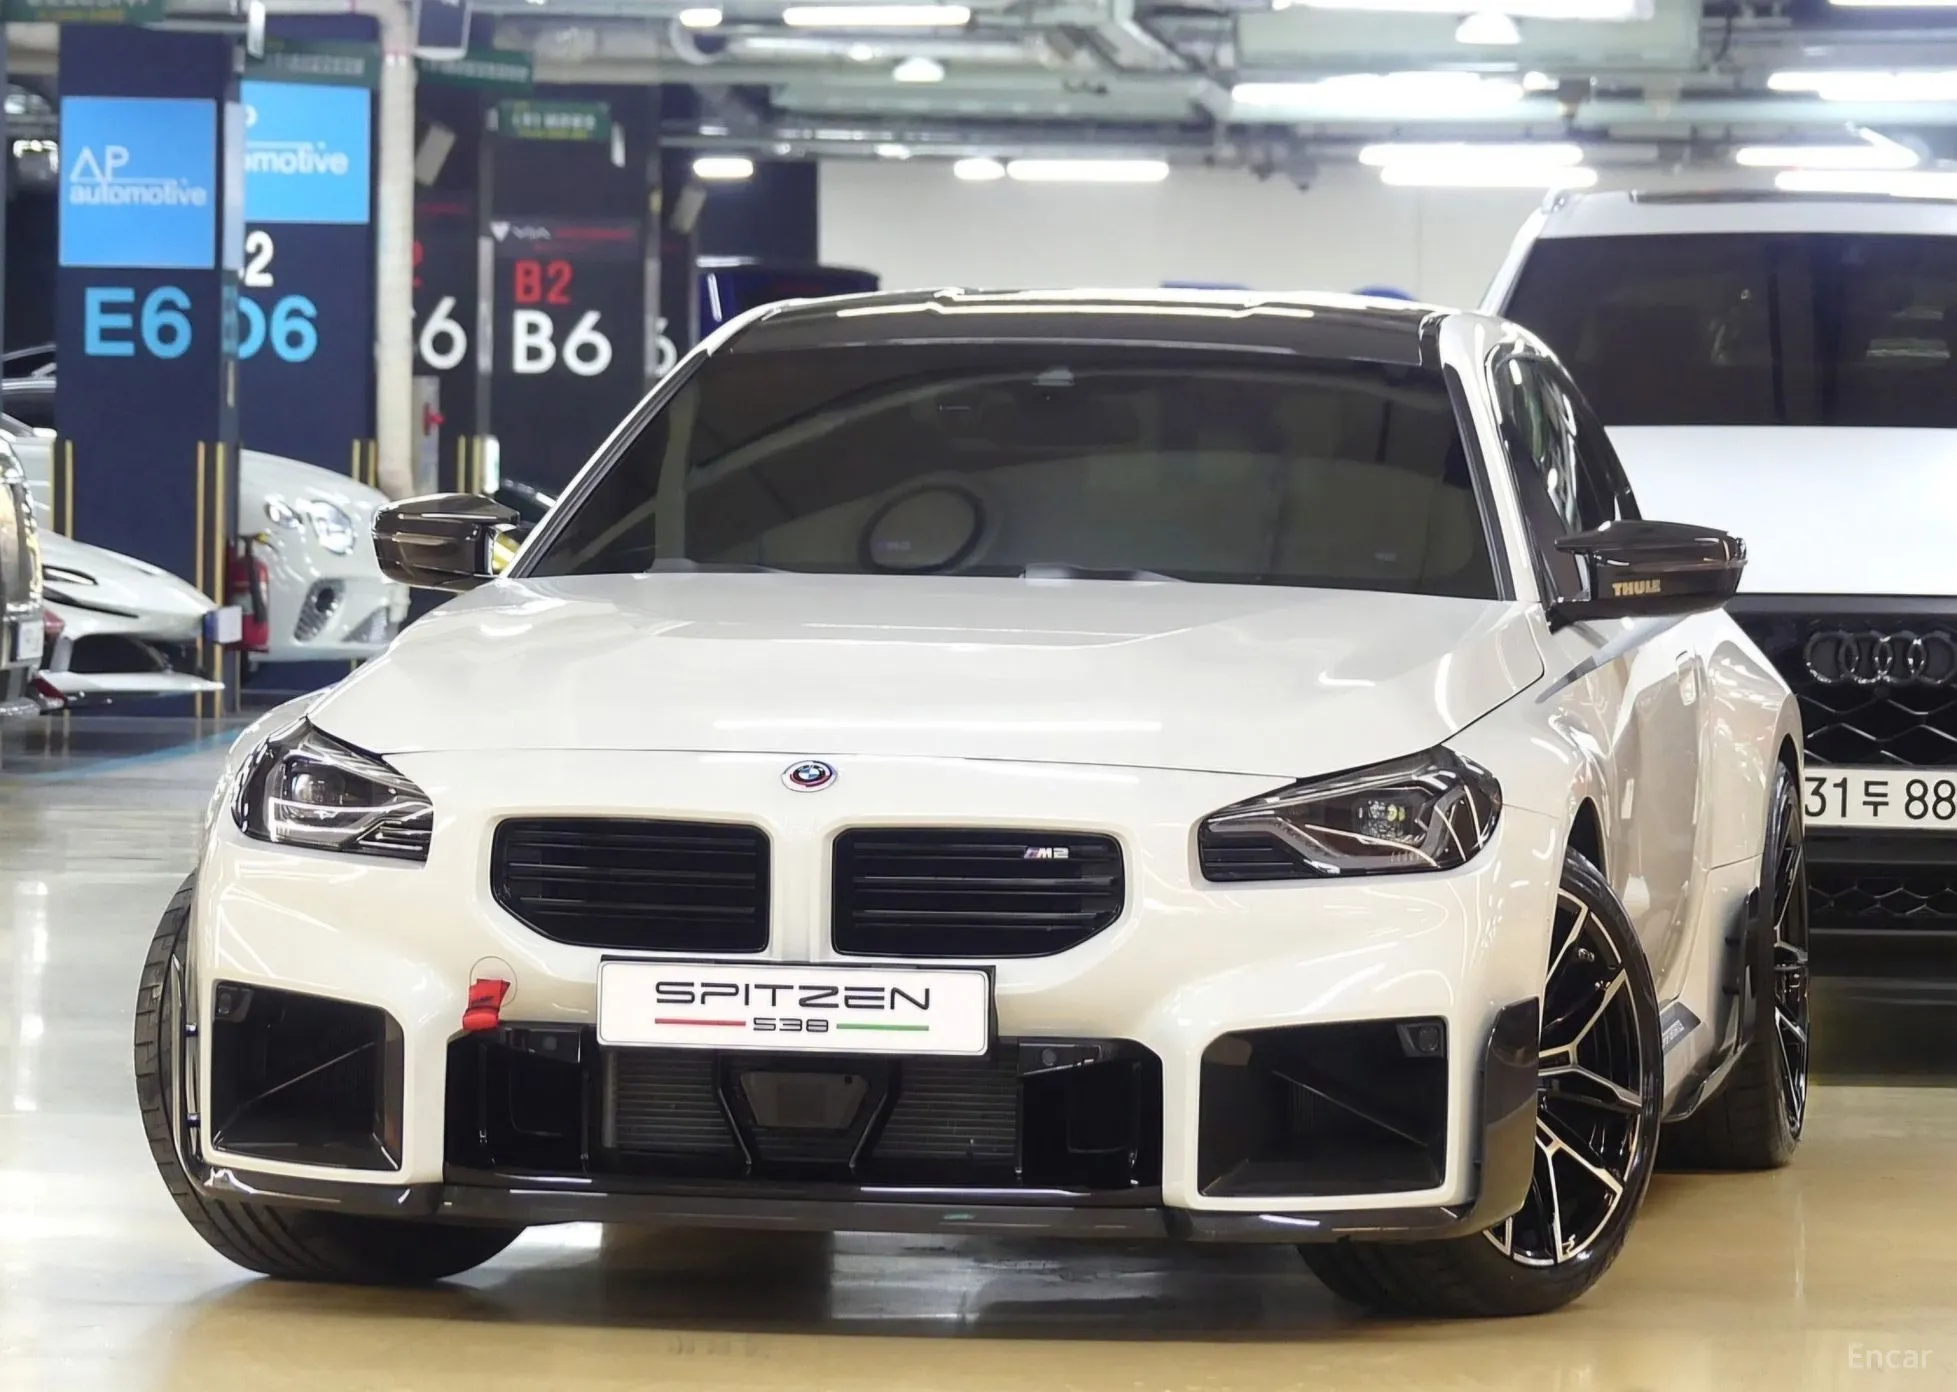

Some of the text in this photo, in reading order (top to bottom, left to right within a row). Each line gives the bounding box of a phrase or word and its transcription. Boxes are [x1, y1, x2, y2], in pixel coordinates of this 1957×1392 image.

[70, 176, 207, 206] automotive
[514, 260, 574, 305] B2
[84, 286, 192, 359] E6
[512, 310, 613, 376] B6
[1612, 579, 1661, 597] THULE
[655, 981, 930, 1011] SPITZEN
